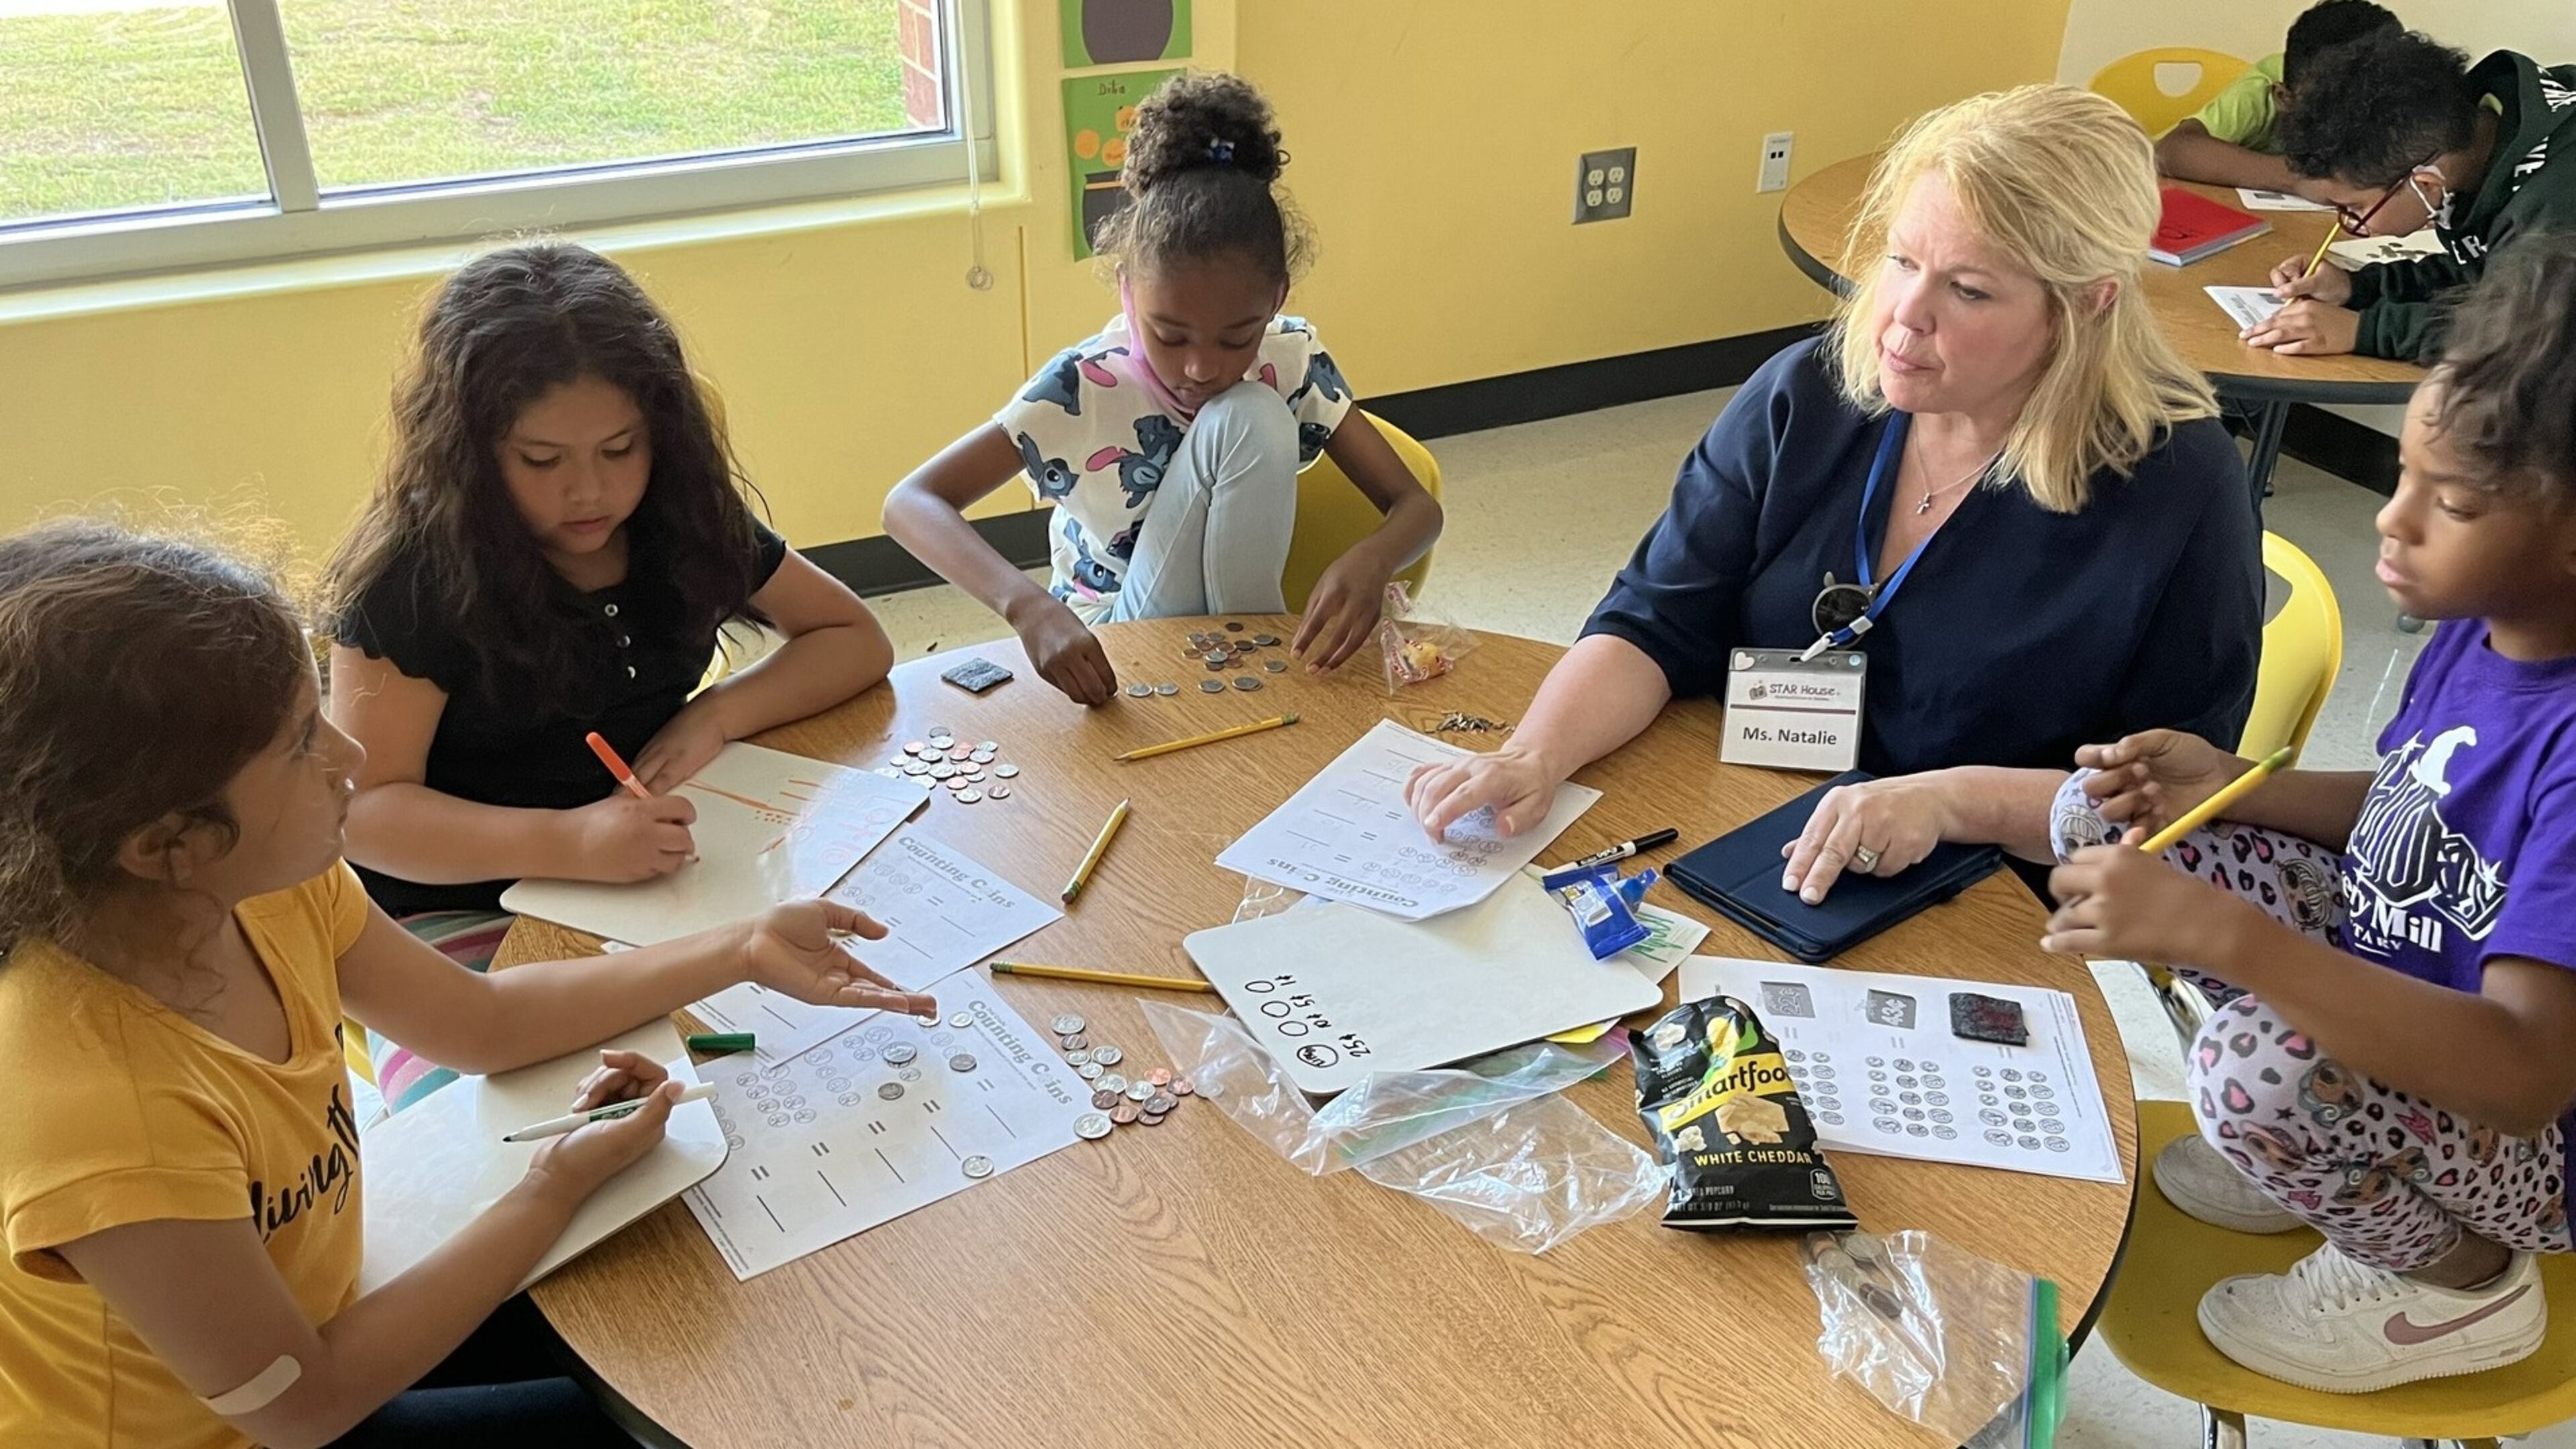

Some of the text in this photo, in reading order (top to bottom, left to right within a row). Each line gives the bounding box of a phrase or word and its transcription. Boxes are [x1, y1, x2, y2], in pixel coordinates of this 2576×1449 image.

[1770, 684, 1797, 694] STAR
[1743, 727, 1837, 745] Ms. Natalie
[899, 836, 970, 883] Counting
[973, 879, 1016, 910] Cins
[1267, 857, 1320, 883] Cins
[1324, 875, 1419, 908] Counting
[2341, 870, 2441, 953] ery Mill
[2350, 919, 2402, 950] TARY
[967, 1000, 1035, 1065] Counting
[1032, 1063, 1073, 1105] Cins
[1694, 1150, 1813, 1167] WHITE CHEDDAR
